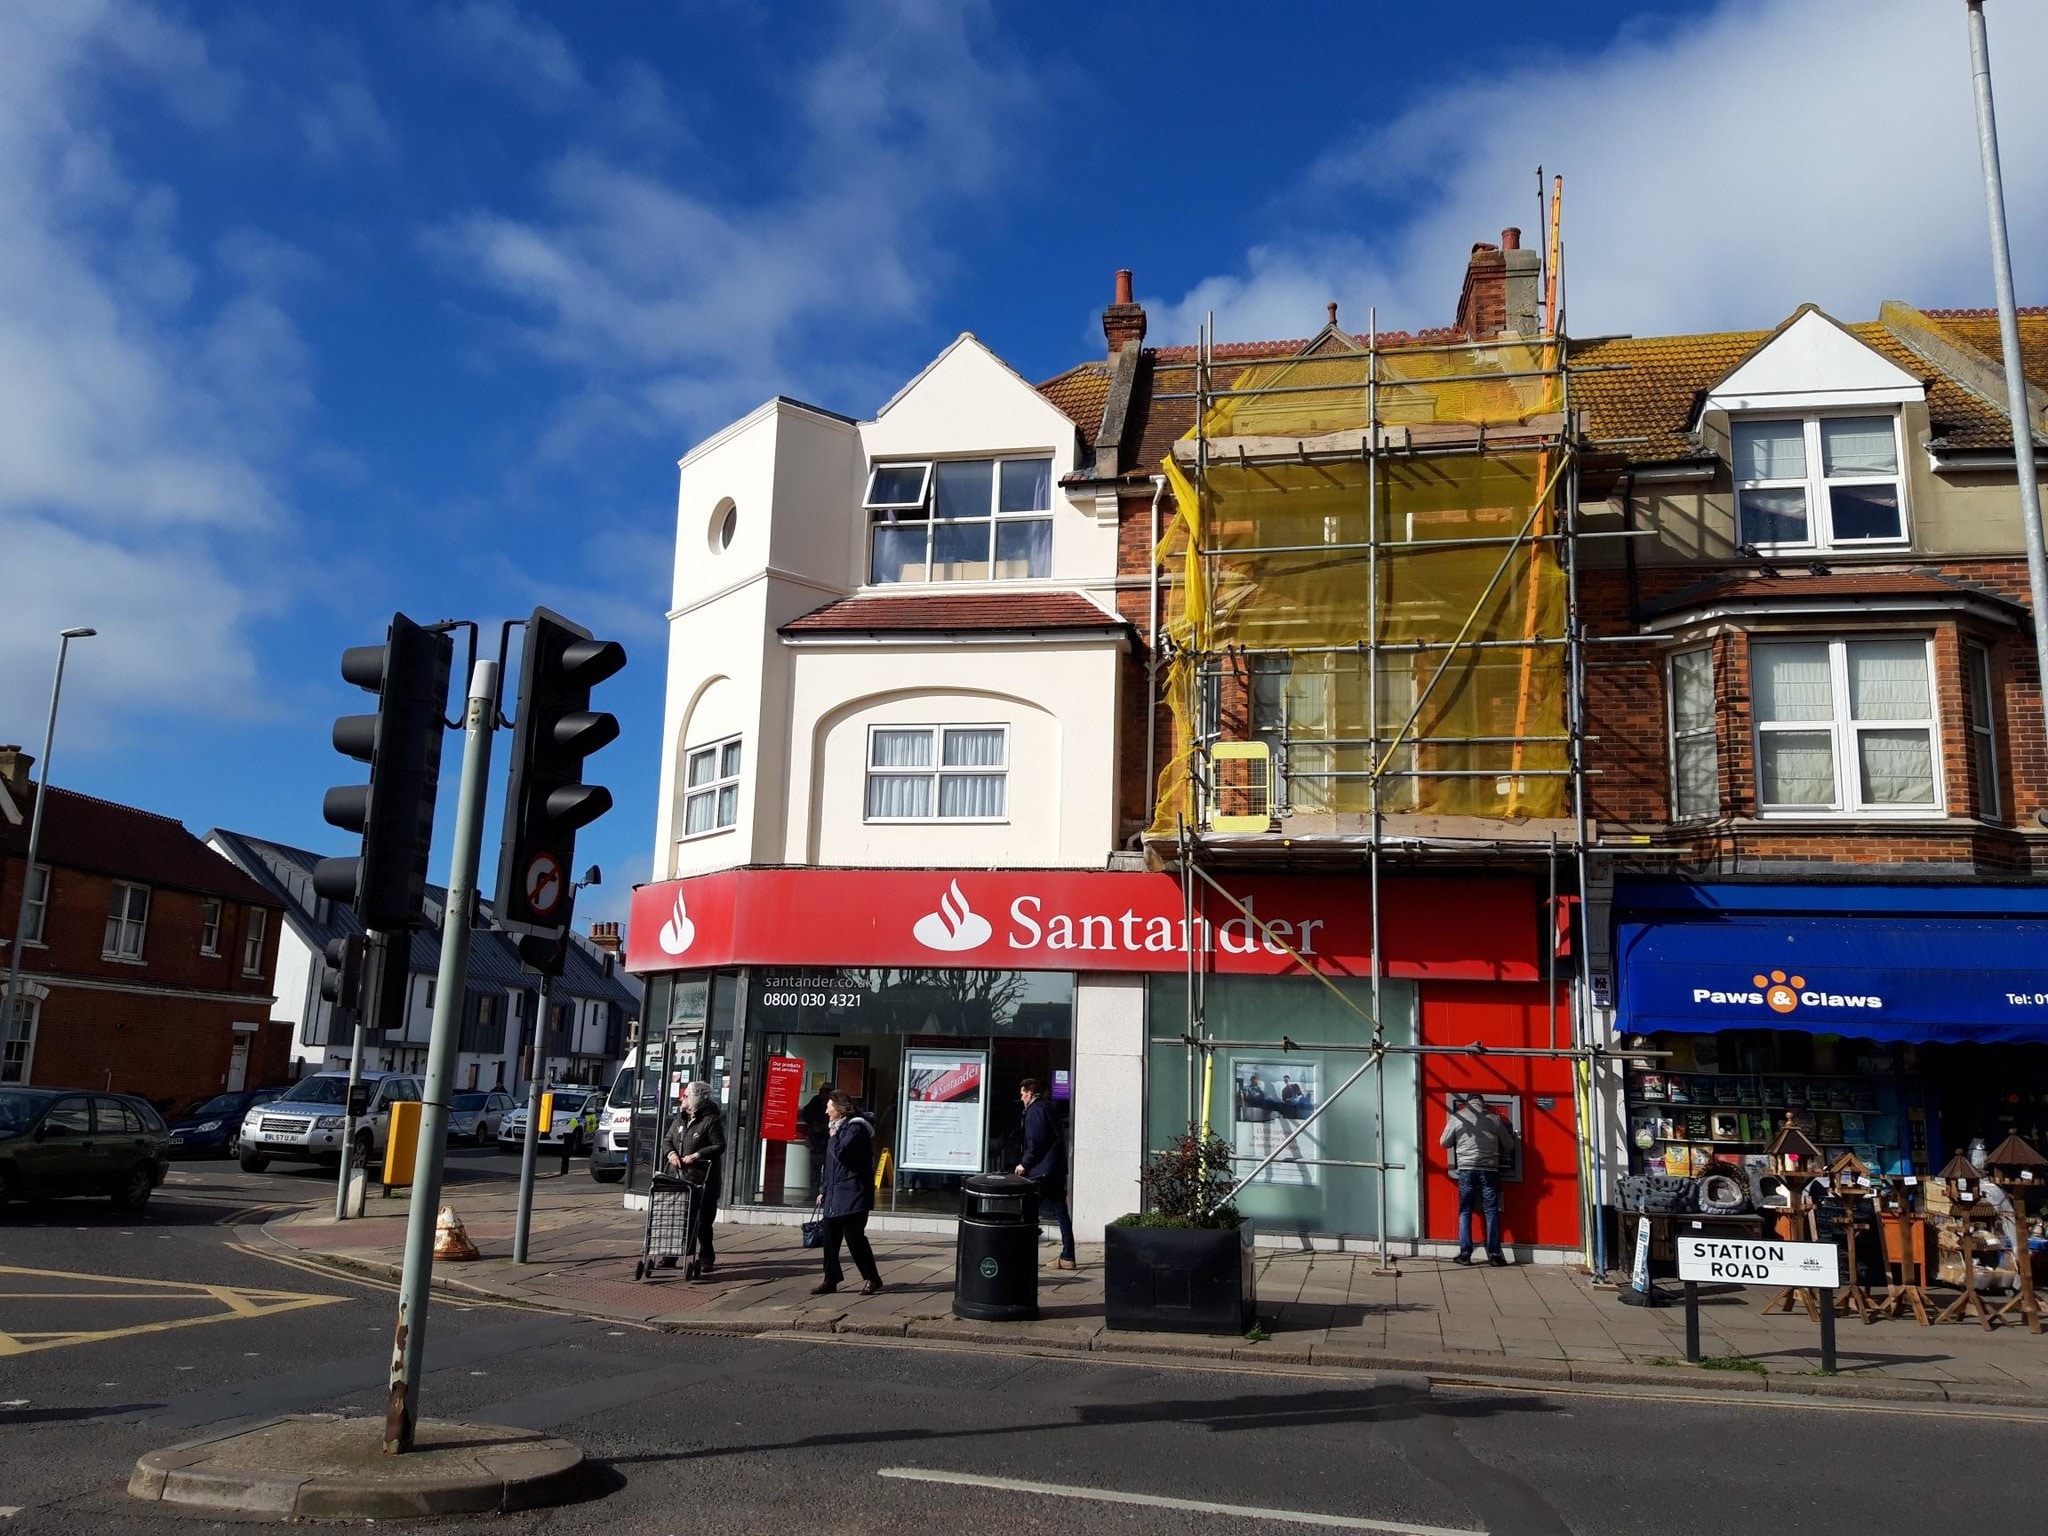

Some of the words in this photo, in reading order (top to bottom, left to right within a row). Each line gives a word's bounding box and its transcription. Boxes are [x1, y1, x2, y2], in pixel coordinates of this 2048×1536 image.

[1008, 895, 1324, 955] Santander
[765, 975, 873, 988] santander.co.uk
[763, 992, 798, 1006] 0800
[801, 993, 826, 1007] 030
[829, 993, 861, 1007] 4321
[1693, 988, 1764, 1005] Paws
[1772, 990, 1793, 1006] &
[1801, 990, 1883, 1009] Claws
[2005, 993, 2032, 1005] Tel:
[938, 1064, 980, 1093] Santander
[1693, 1243, 1784, 1261] STATION
[1711, 1262, 1770, 1279] ROAD
